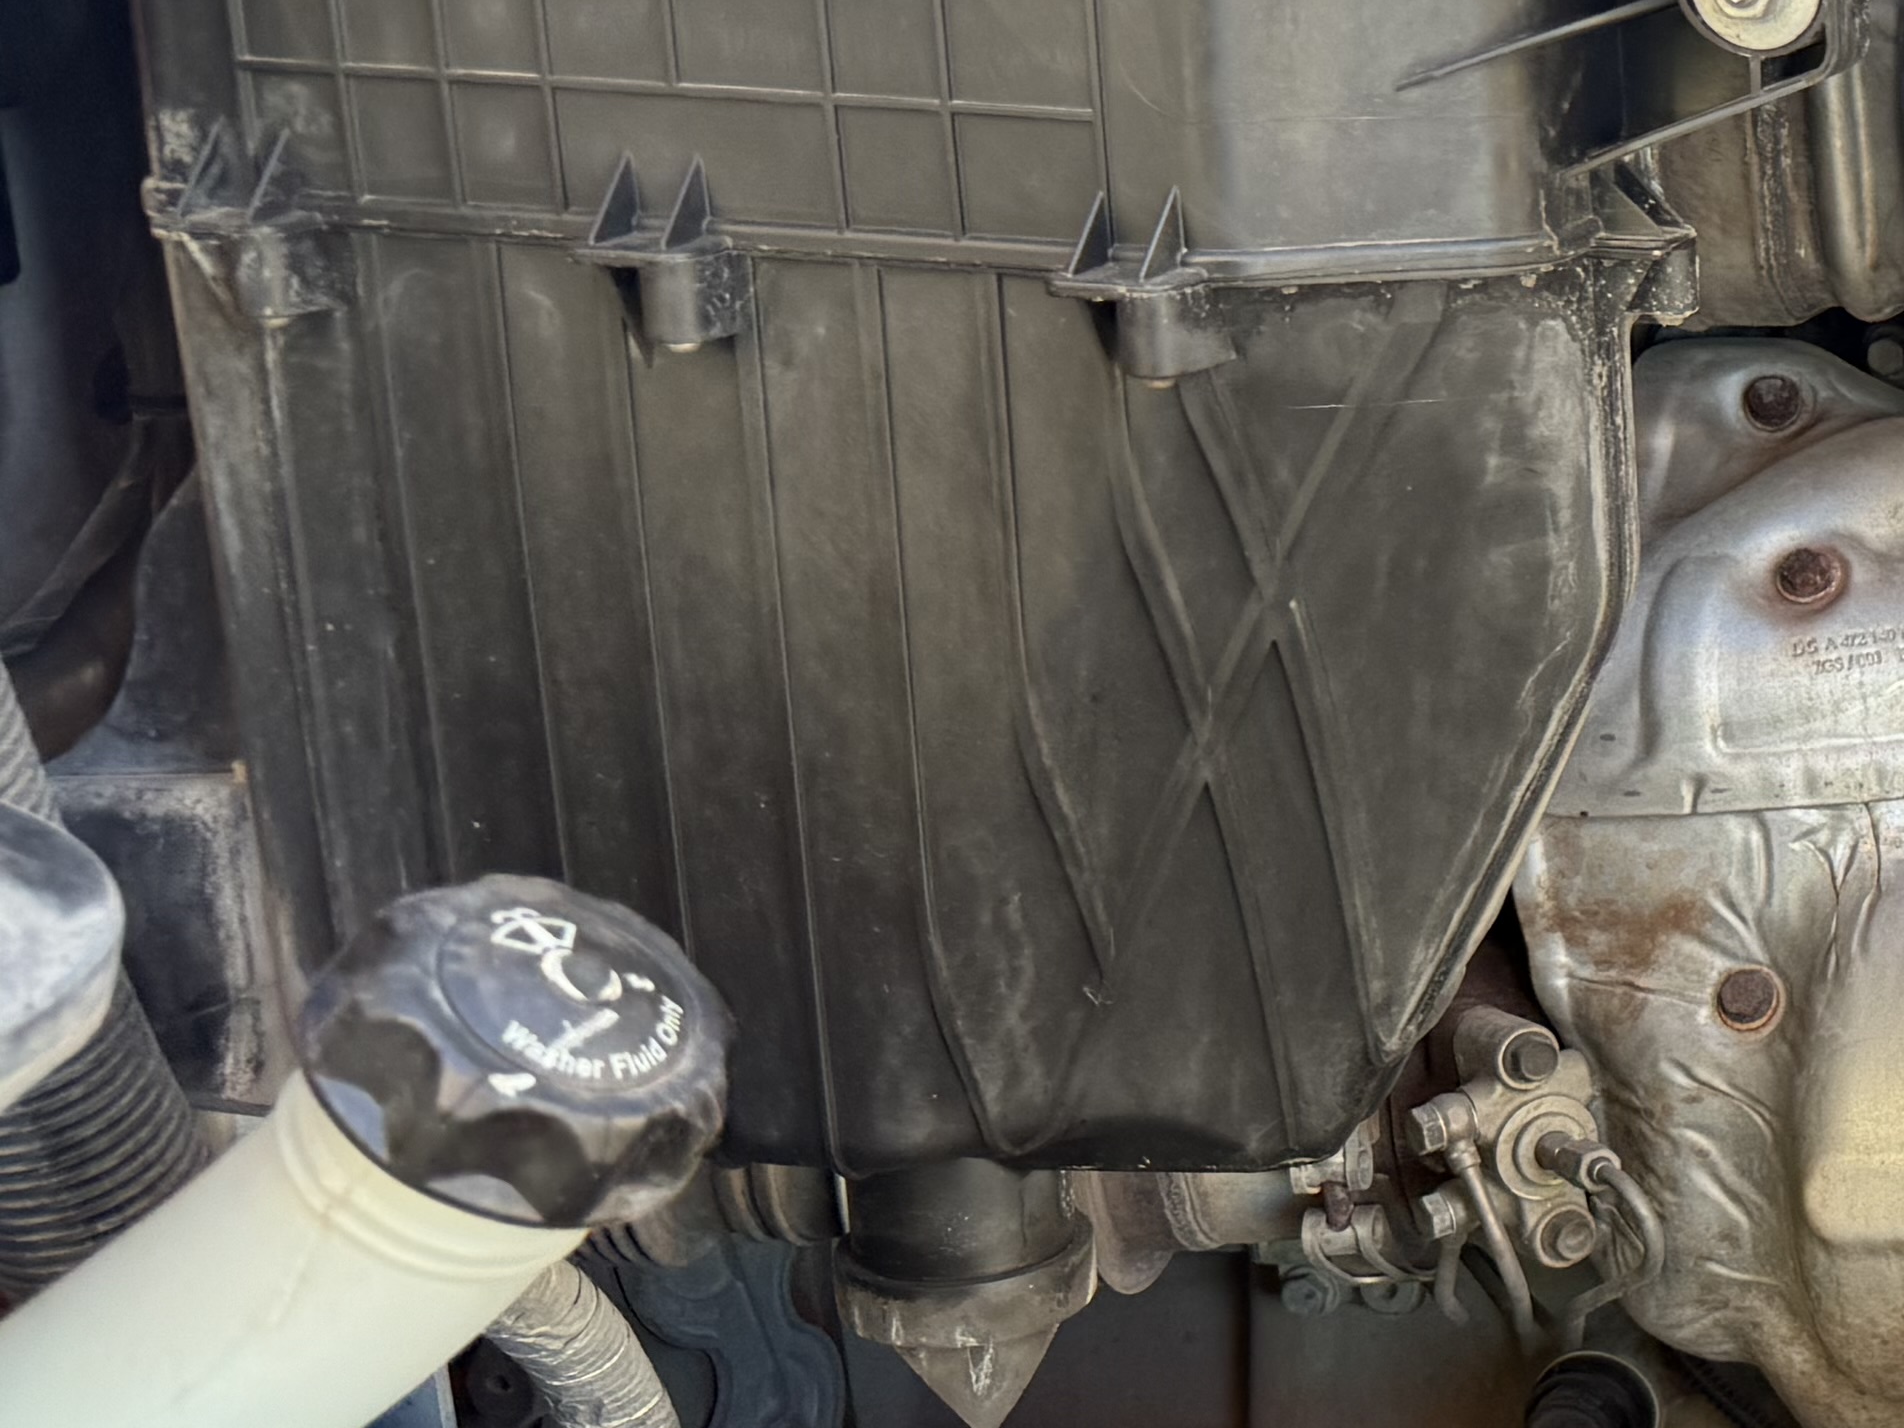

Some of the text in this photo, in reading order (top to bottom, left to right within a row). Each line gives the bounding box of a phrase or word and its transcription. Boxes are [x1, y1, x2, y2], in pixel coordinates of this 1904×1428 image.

[502, 995, 684, 1080] Washer Fluid Only
